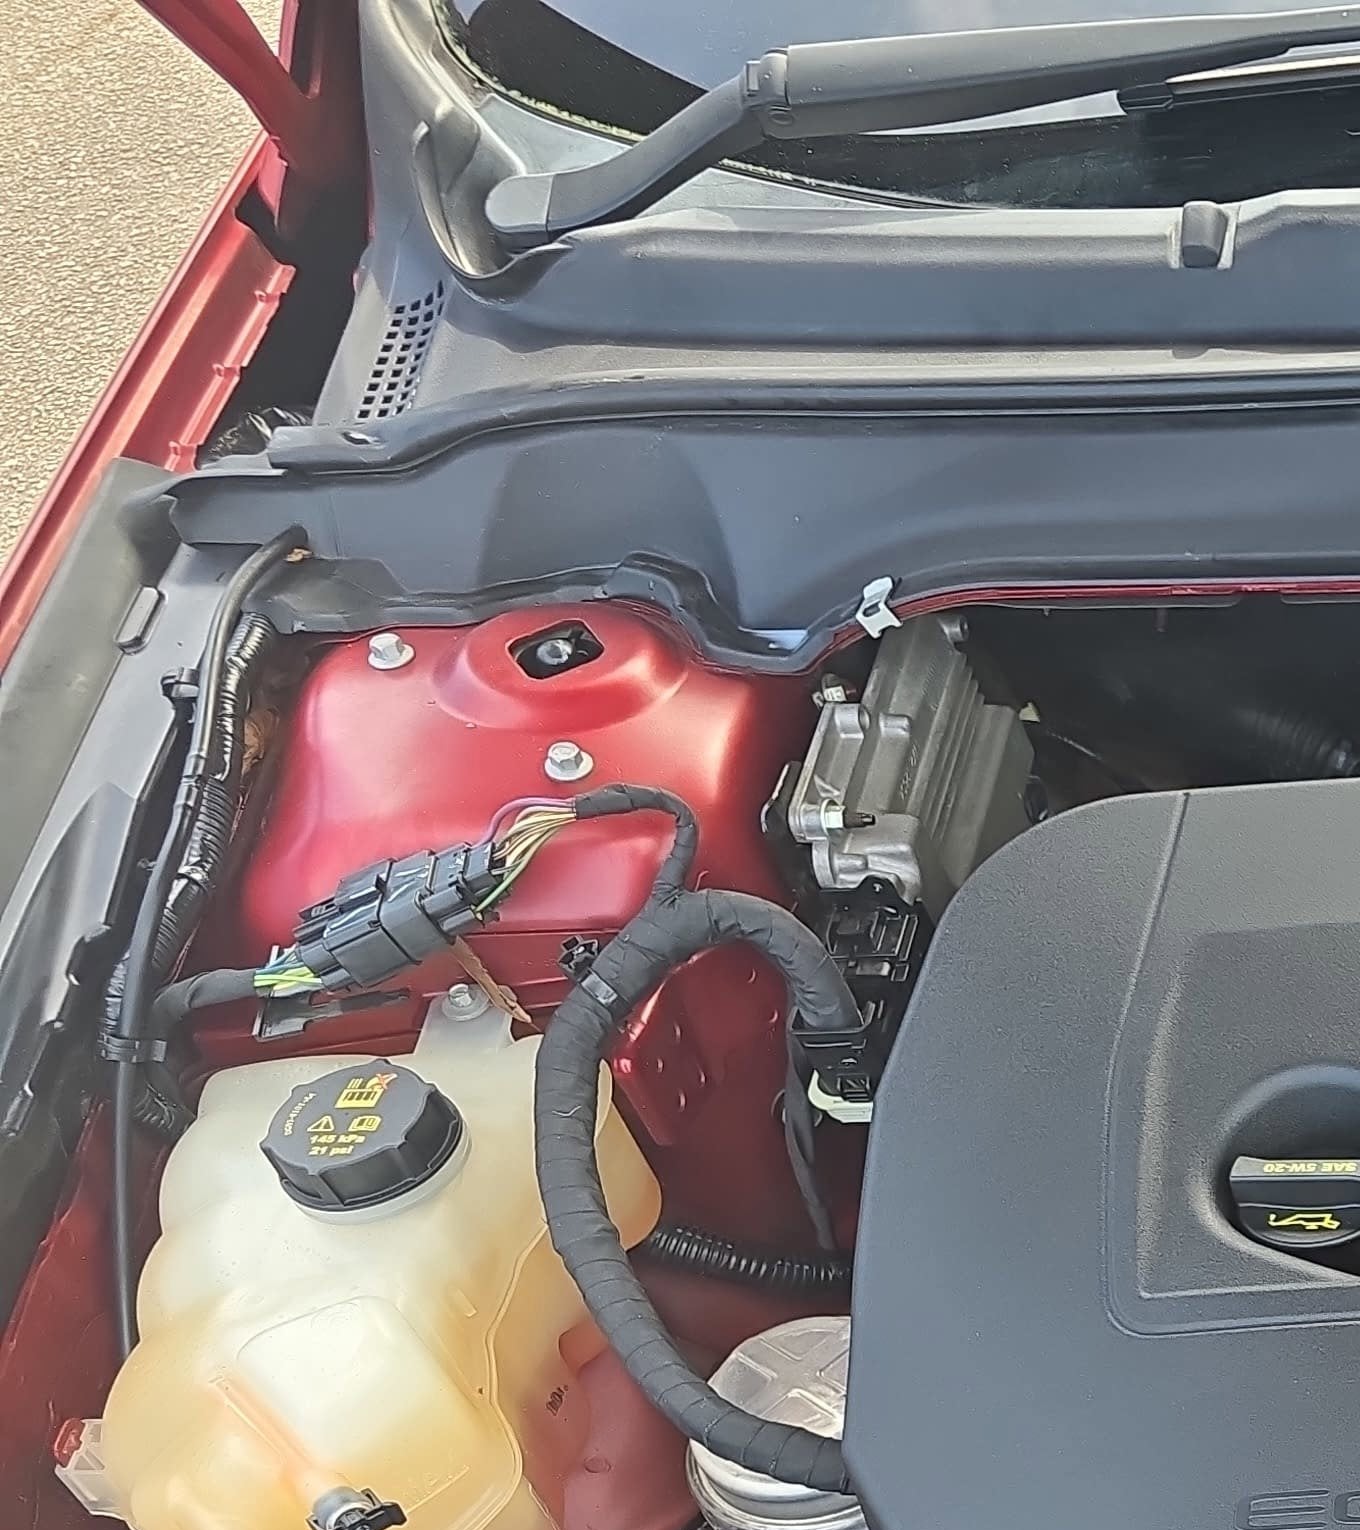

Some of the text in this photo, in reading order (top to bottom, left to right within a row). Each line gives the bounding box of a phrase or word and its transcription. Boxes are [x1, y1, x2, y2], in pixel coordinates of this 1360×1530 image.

[309, 1133, 366, 1145] 145 kPa
[308, 1145, 354, 1158] 21 psi
[1263, 1162, 1358, 1173] SAE 5W-20
